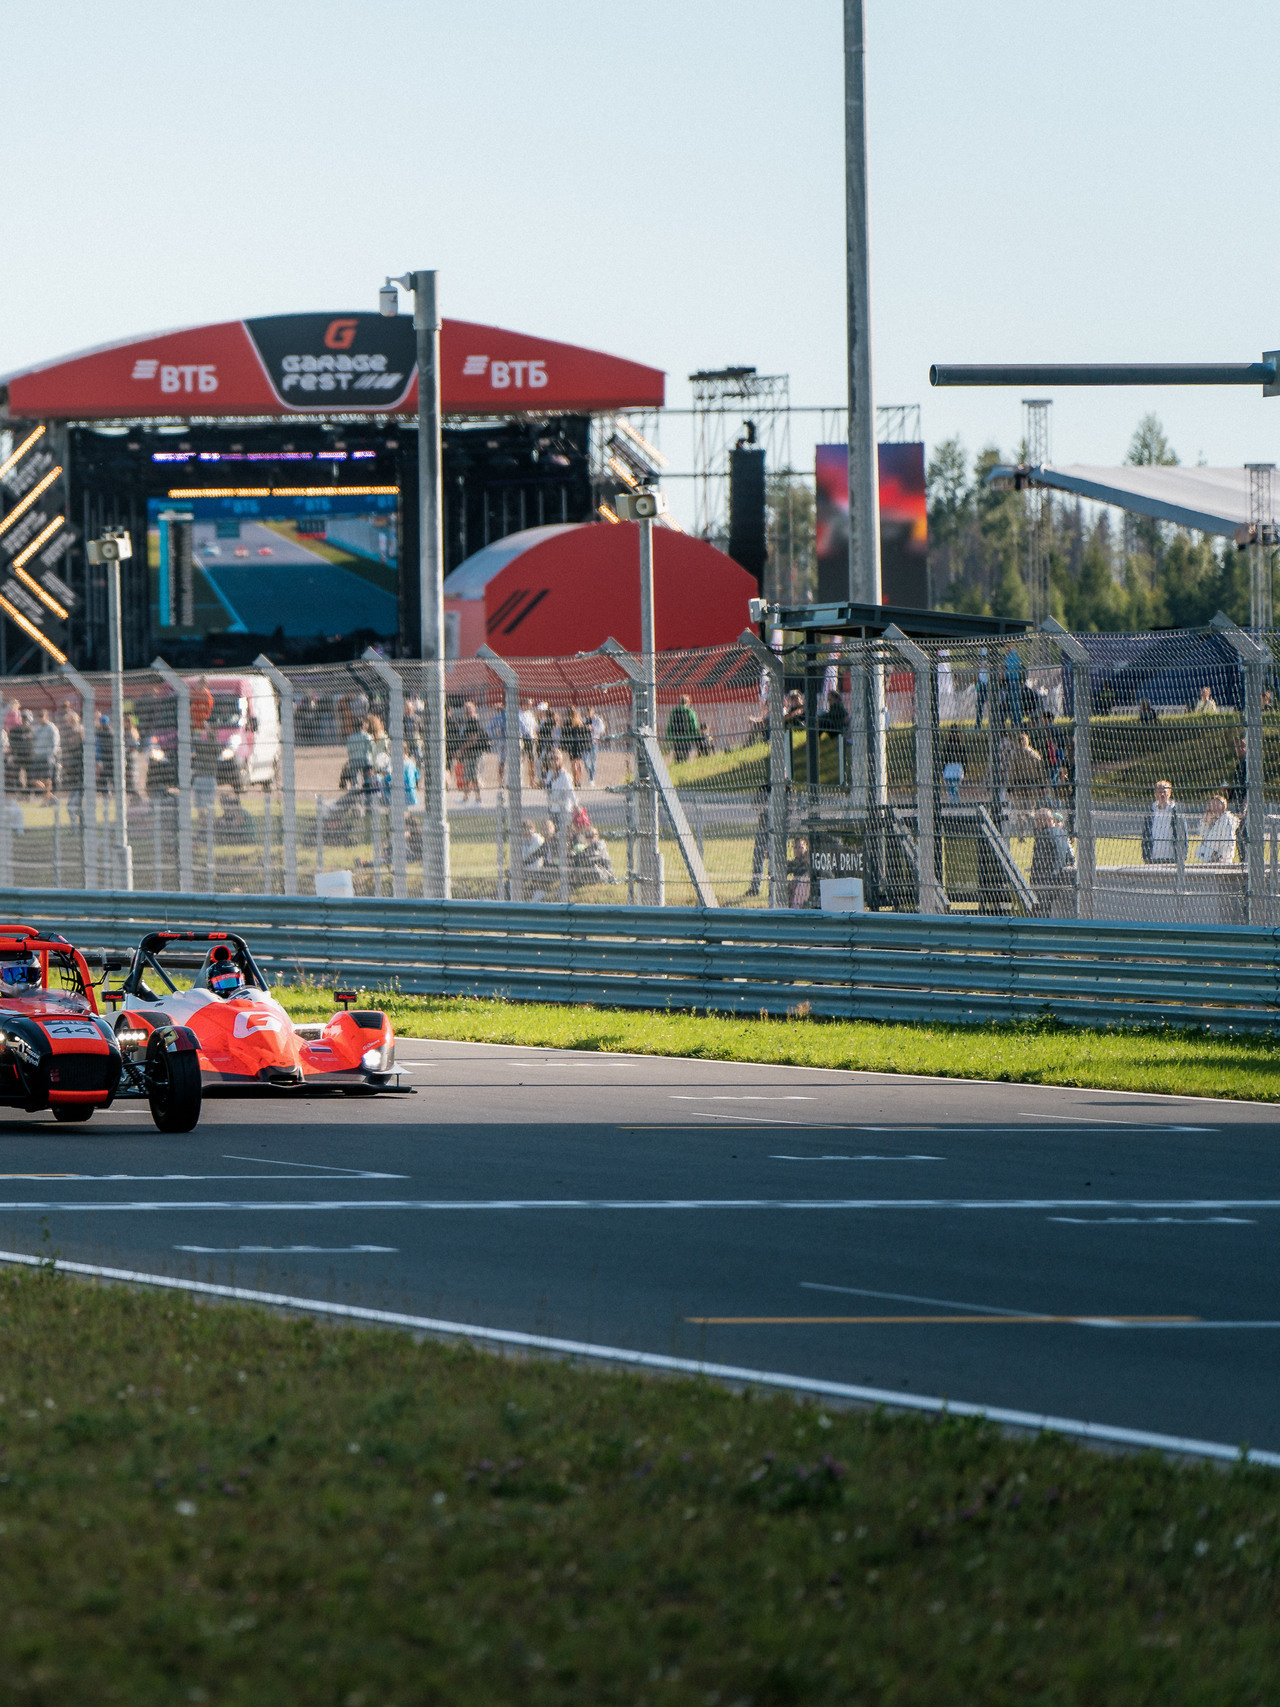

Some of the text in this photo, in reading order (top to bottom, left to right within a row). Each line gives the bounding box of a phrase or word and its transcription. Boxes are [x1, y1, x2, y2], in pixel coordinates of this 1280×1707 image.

[323, 318, 359, 349] G
[160, 364, 219, 393] ВТБ
[490, 360, 549, 389] ВТБ
[840, 852, 864, 871] DRIVE
[51, 1026, 96, 1035] 44
